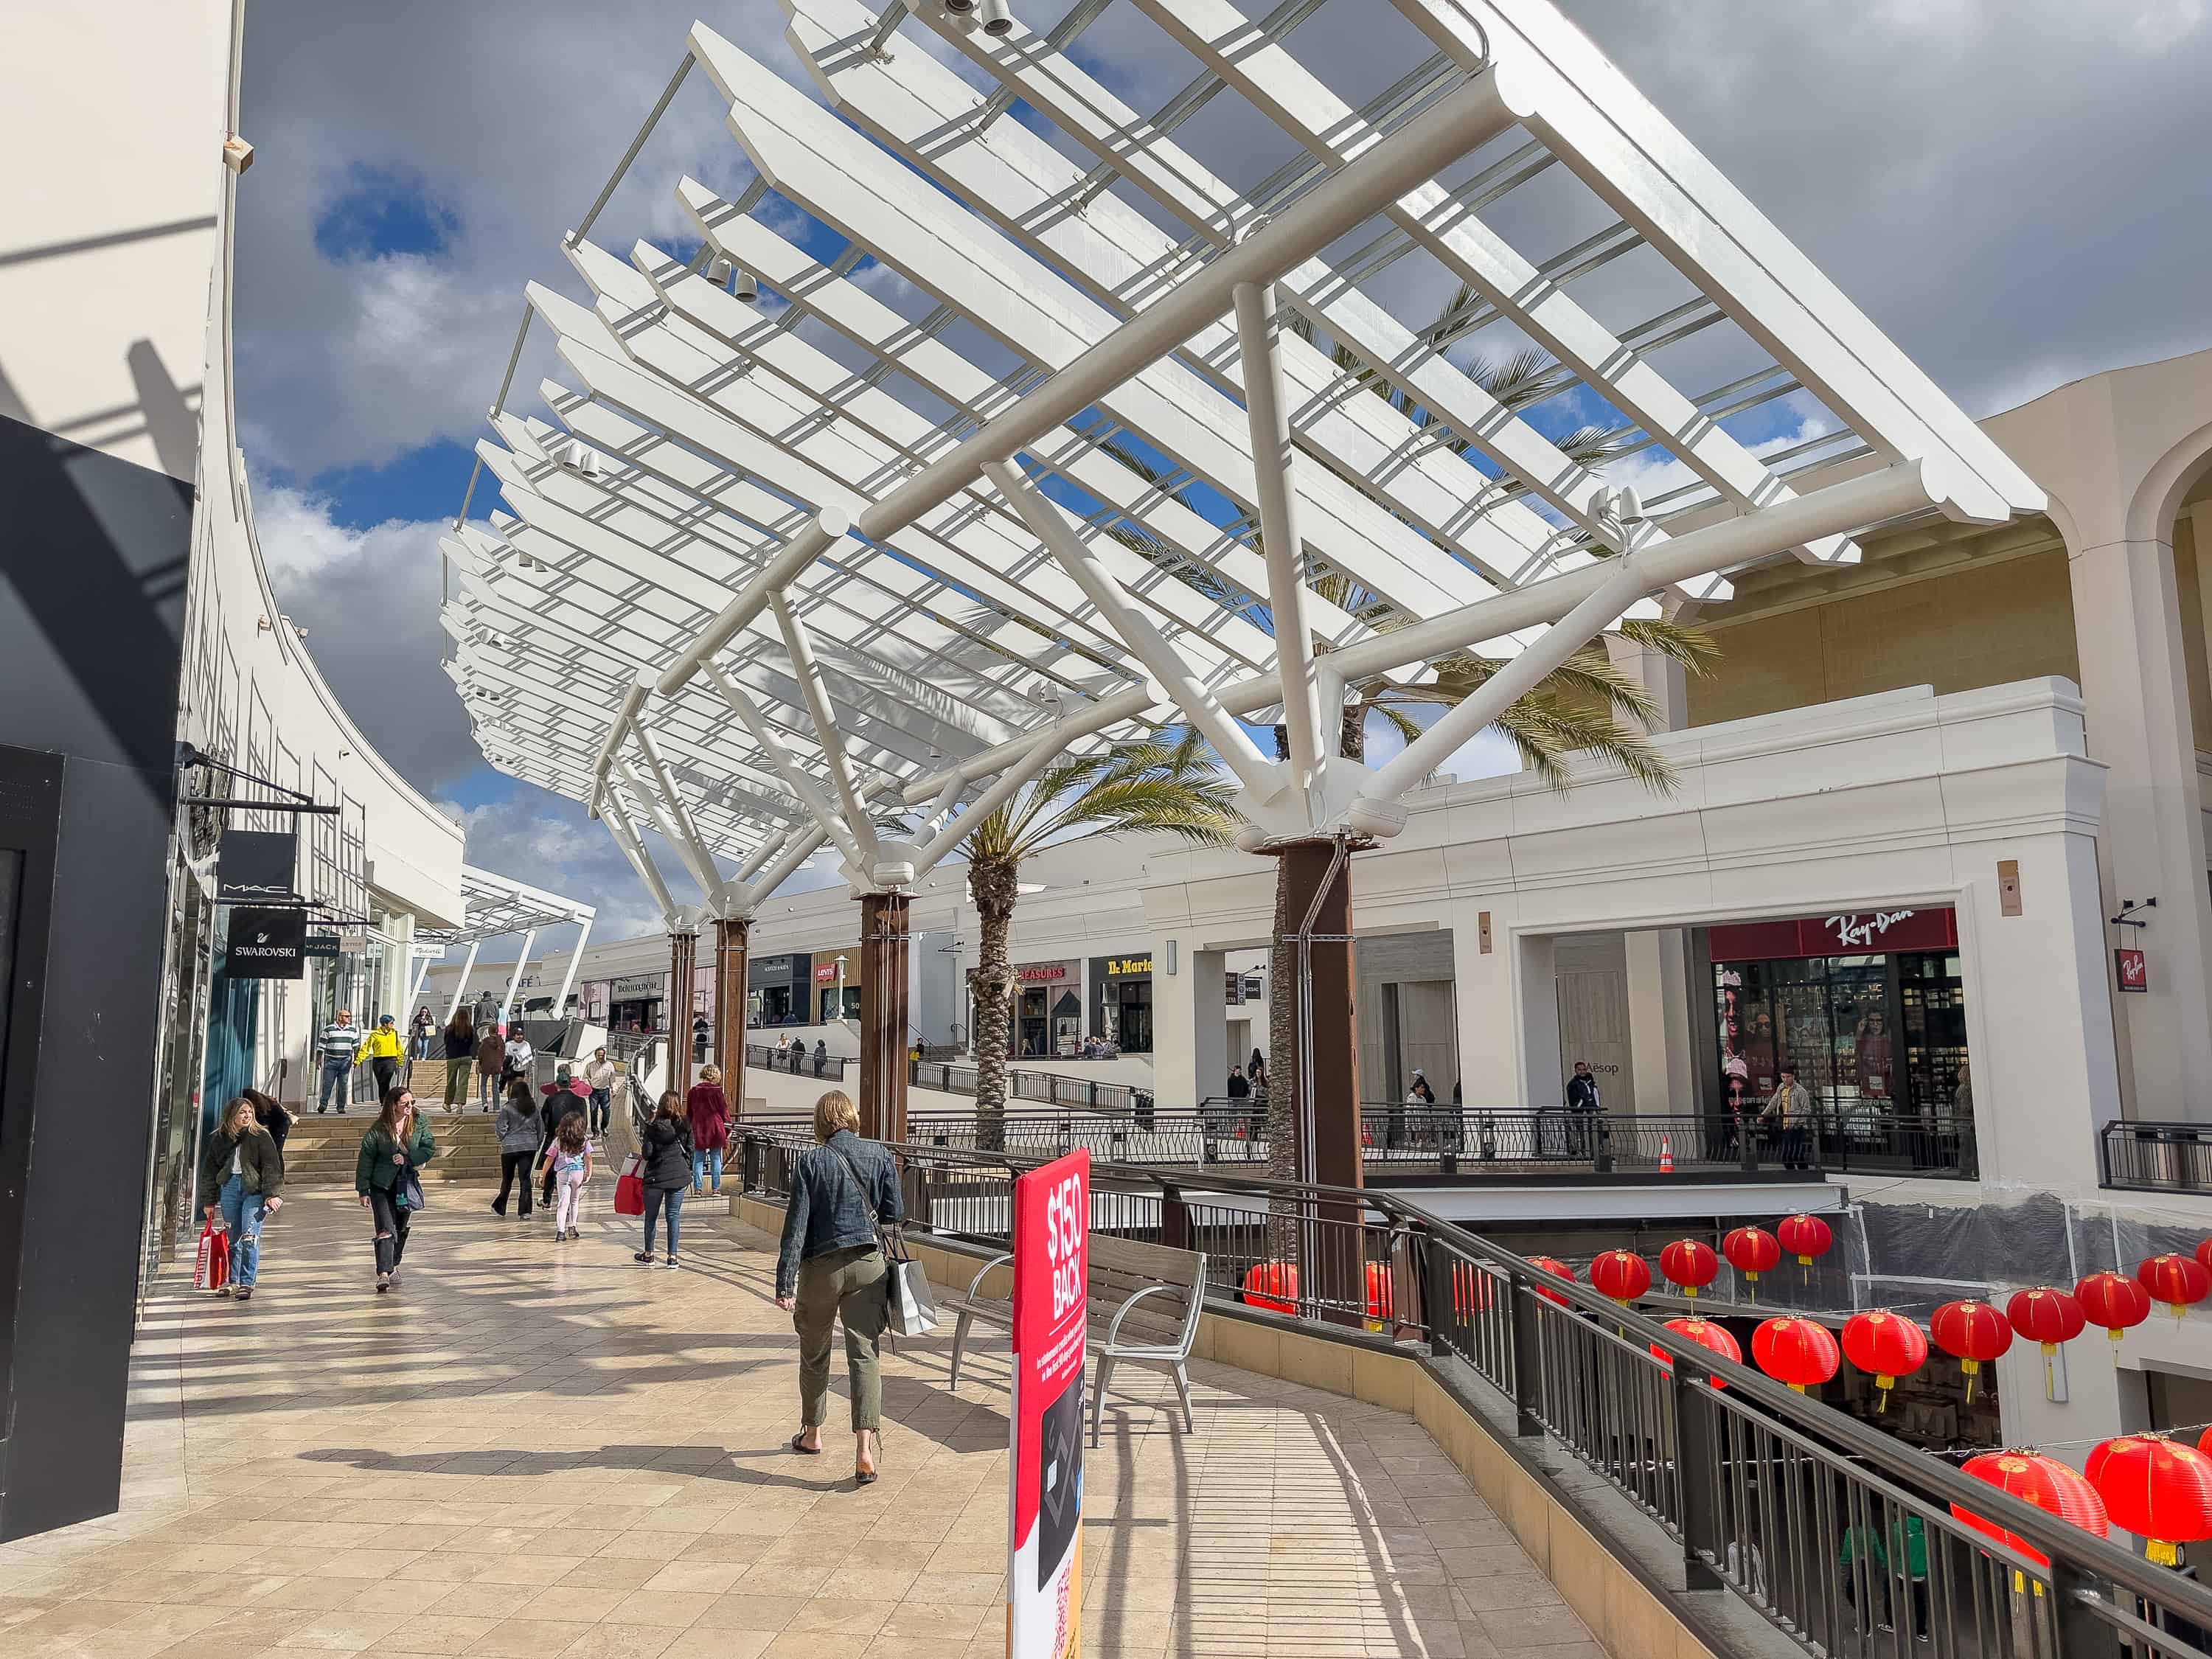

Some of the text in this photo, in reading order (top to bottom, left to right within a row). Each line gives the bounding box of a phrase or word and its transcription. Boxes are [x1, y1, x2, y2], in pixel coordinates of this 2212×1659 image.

[235, 947, 296, 957] SWAROVSKI
[1108, 961, 1120, 975] Dr.
[1047, 1172, 1082, 1267] $150
[1053, 1251, 1082, 1321] BACK
